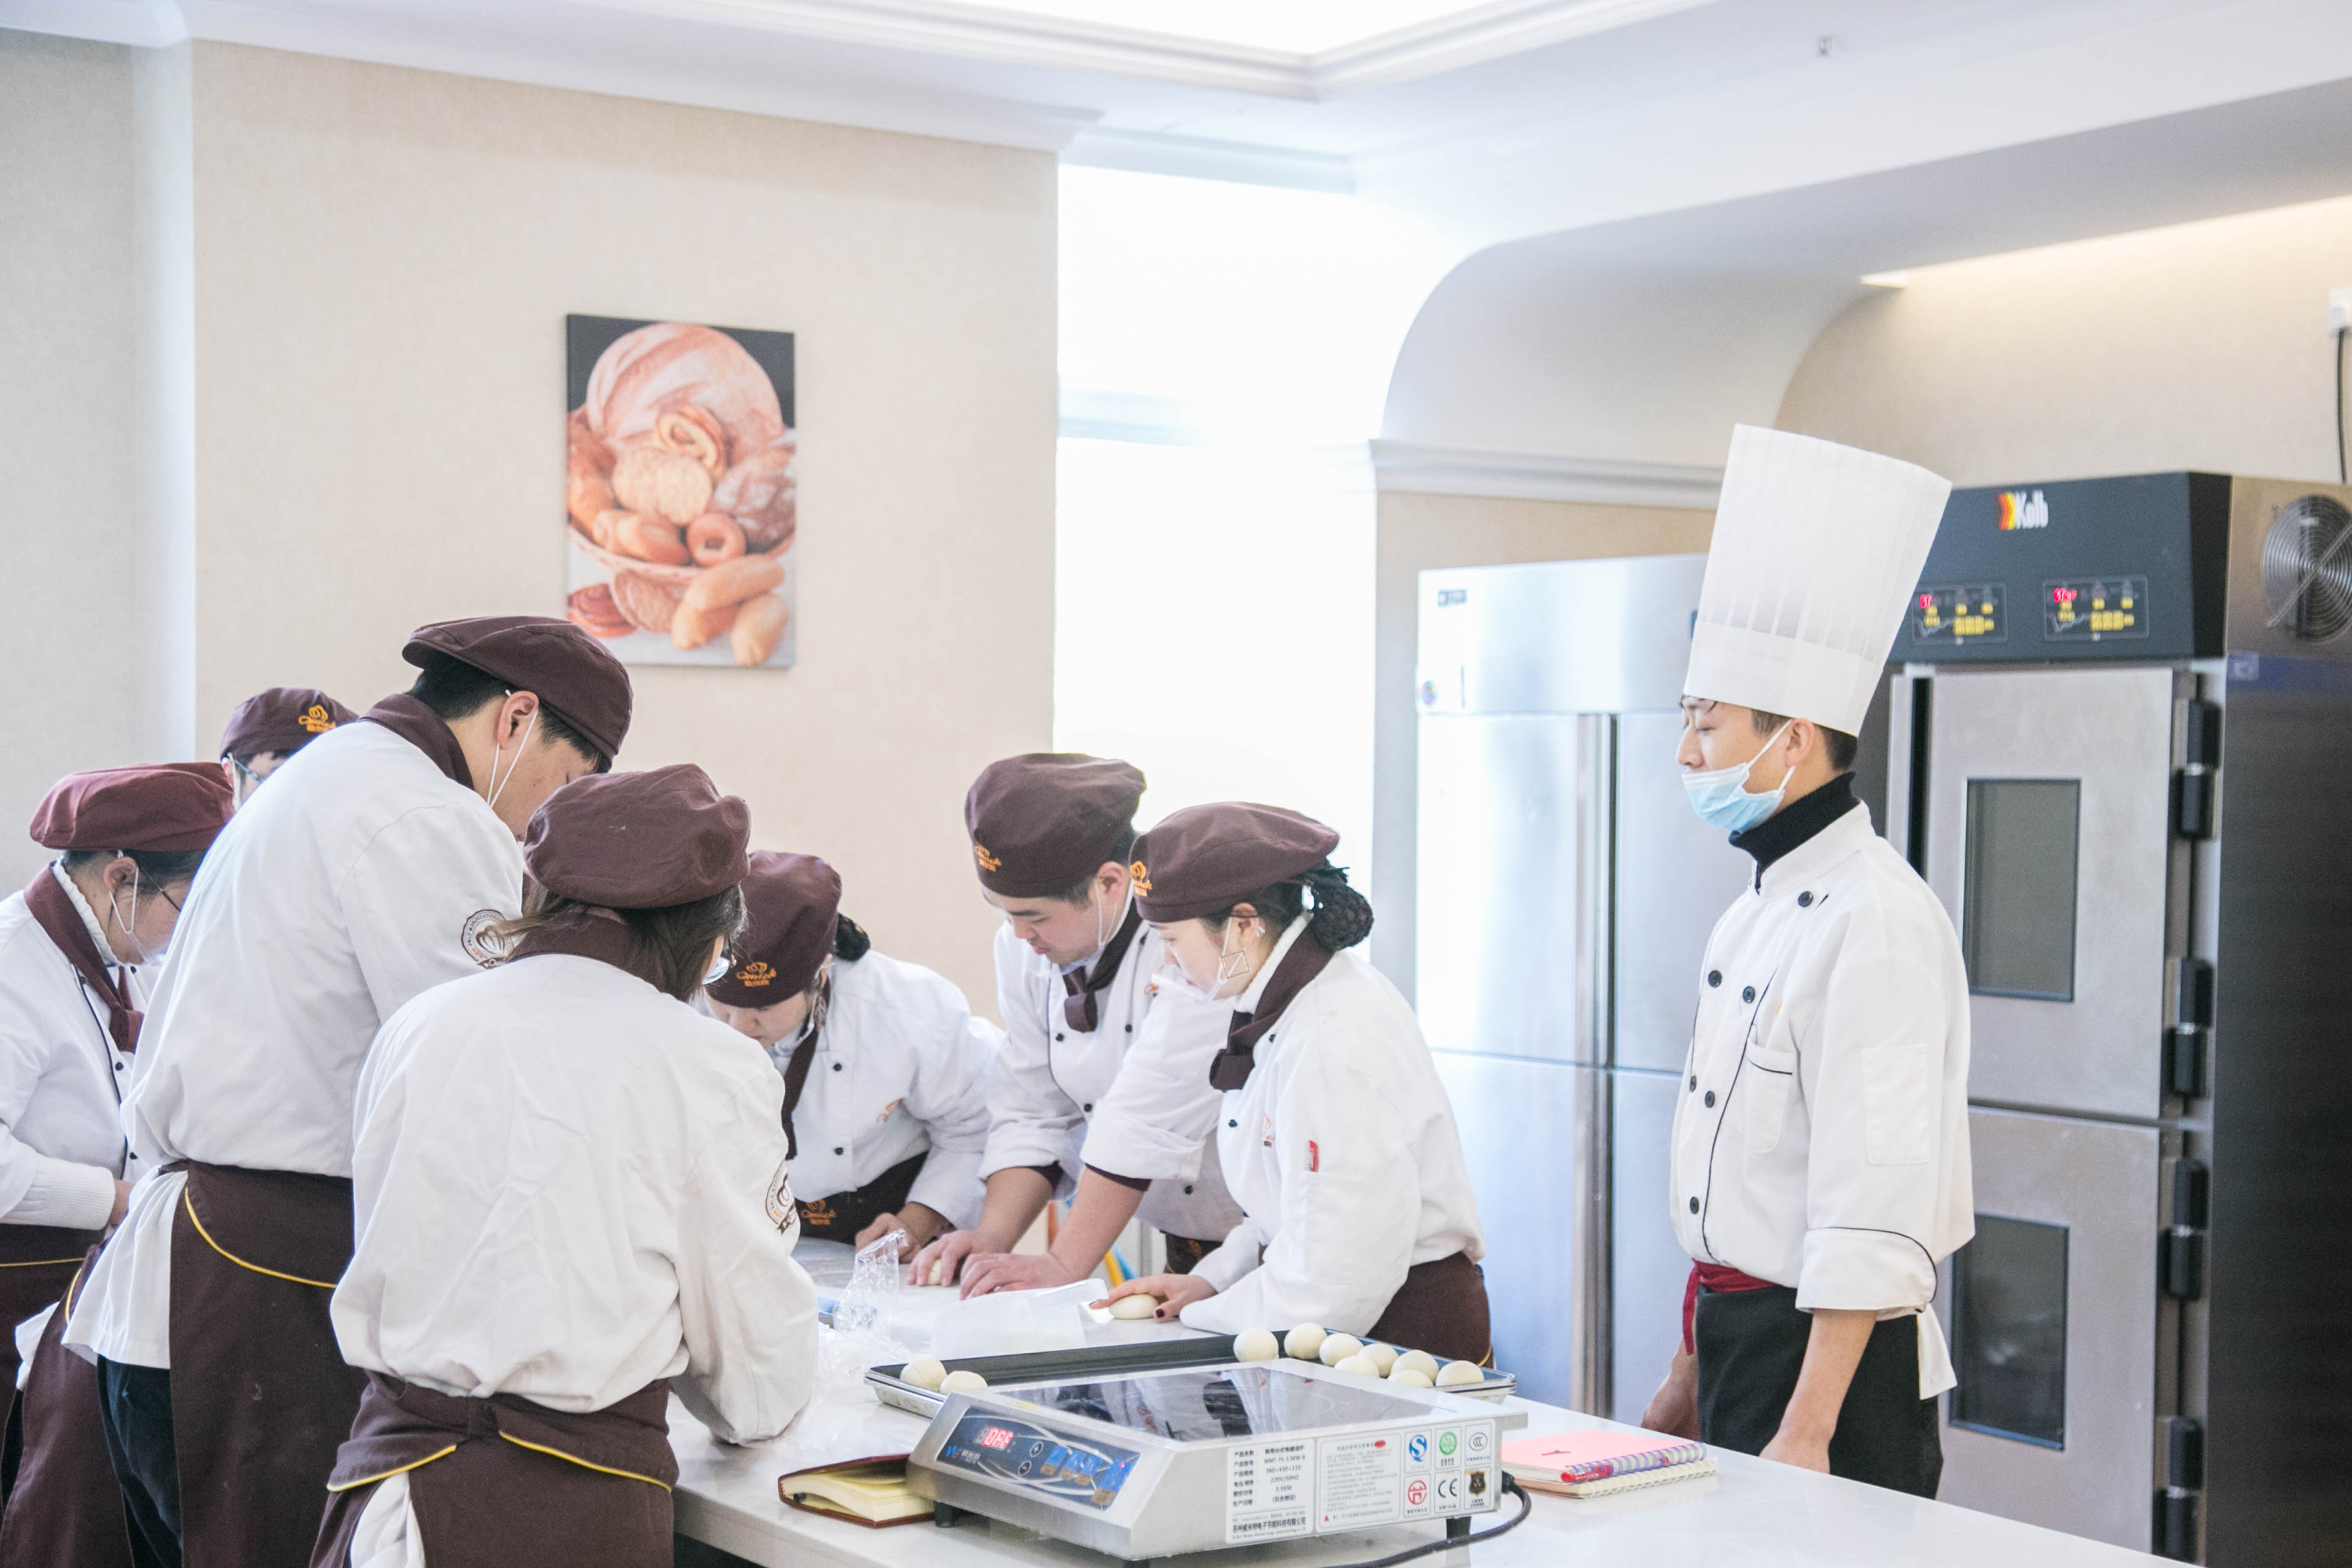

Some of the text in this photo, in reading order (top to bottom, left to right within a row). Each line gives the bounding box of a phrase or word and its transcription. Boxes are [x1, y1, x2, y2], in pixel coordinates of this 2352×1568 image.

[2015, 490, 2048, 529] Kolb
[983, 1427, 1013, 1450] OFF
[1438, 1478, 1457, 1499] CE
